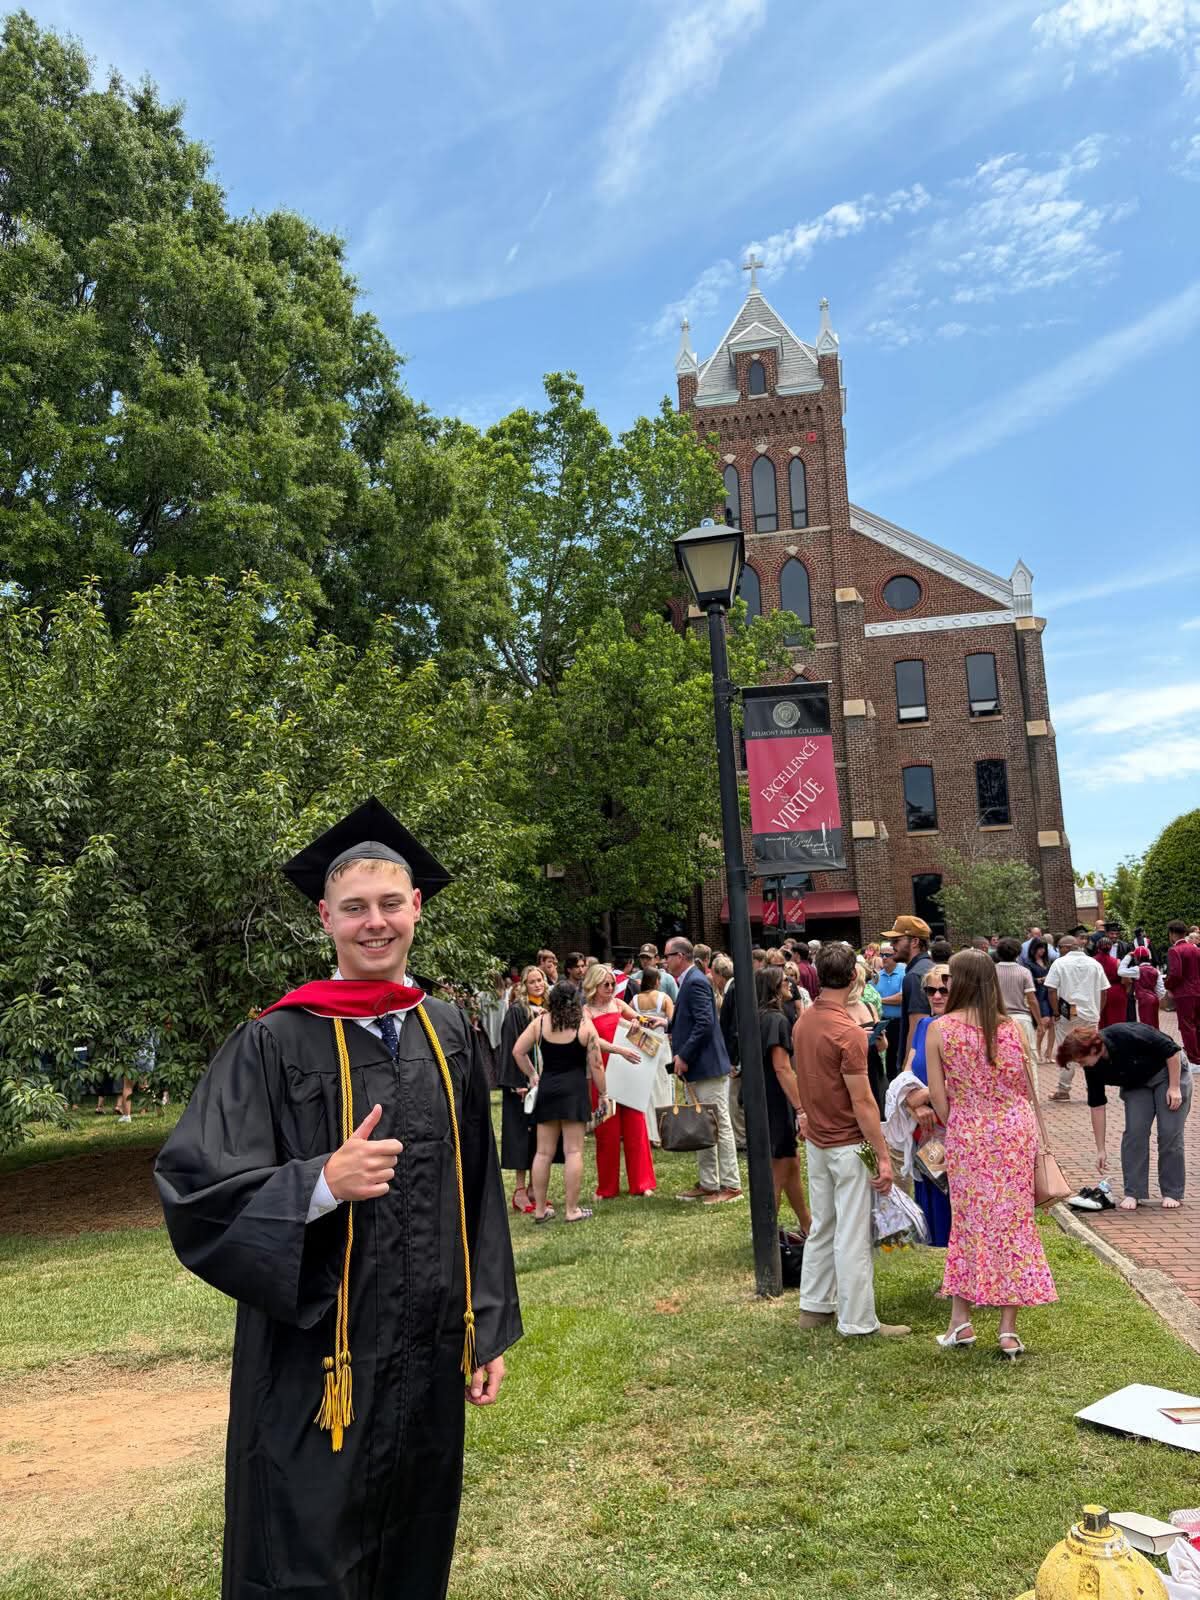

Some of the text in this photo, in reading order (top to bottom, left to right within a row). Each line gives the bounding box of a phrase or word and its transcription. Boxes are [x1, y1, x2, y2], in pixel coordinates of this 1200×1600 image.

[752, 726, 824, 737] BELMONT ABBEY COLLEGE
[760, 740, 819, 803] EXCELLENCE
[770, 778, 825, 830] VIRTUE
